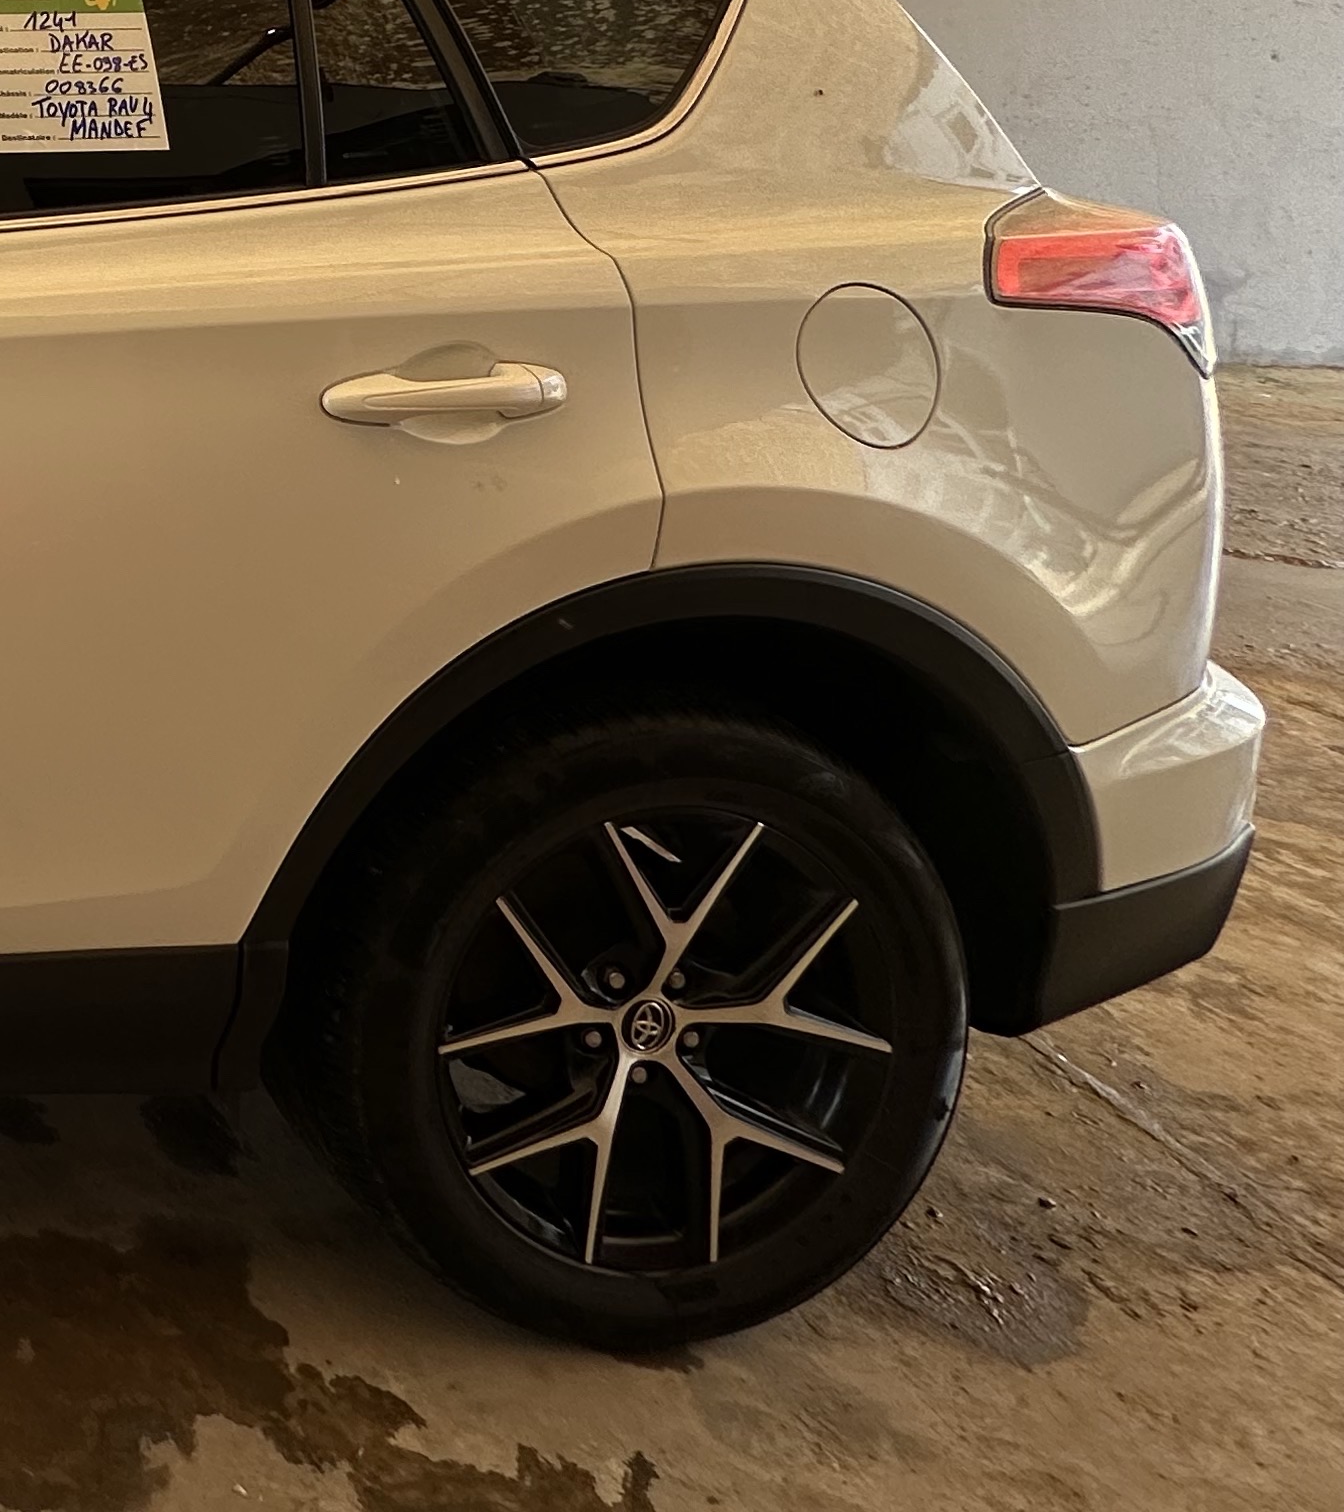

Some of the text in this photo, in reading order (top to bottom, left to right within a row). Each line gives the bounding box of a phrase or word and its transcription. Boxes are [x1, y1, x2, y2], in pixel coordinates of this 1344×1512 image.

[48, 29, 115, 54] DAKAR
[45, 76, 124, 95] 008366
[31, 96, 98, 127] TOYOTA
[143, 96, 153, 125] 4
